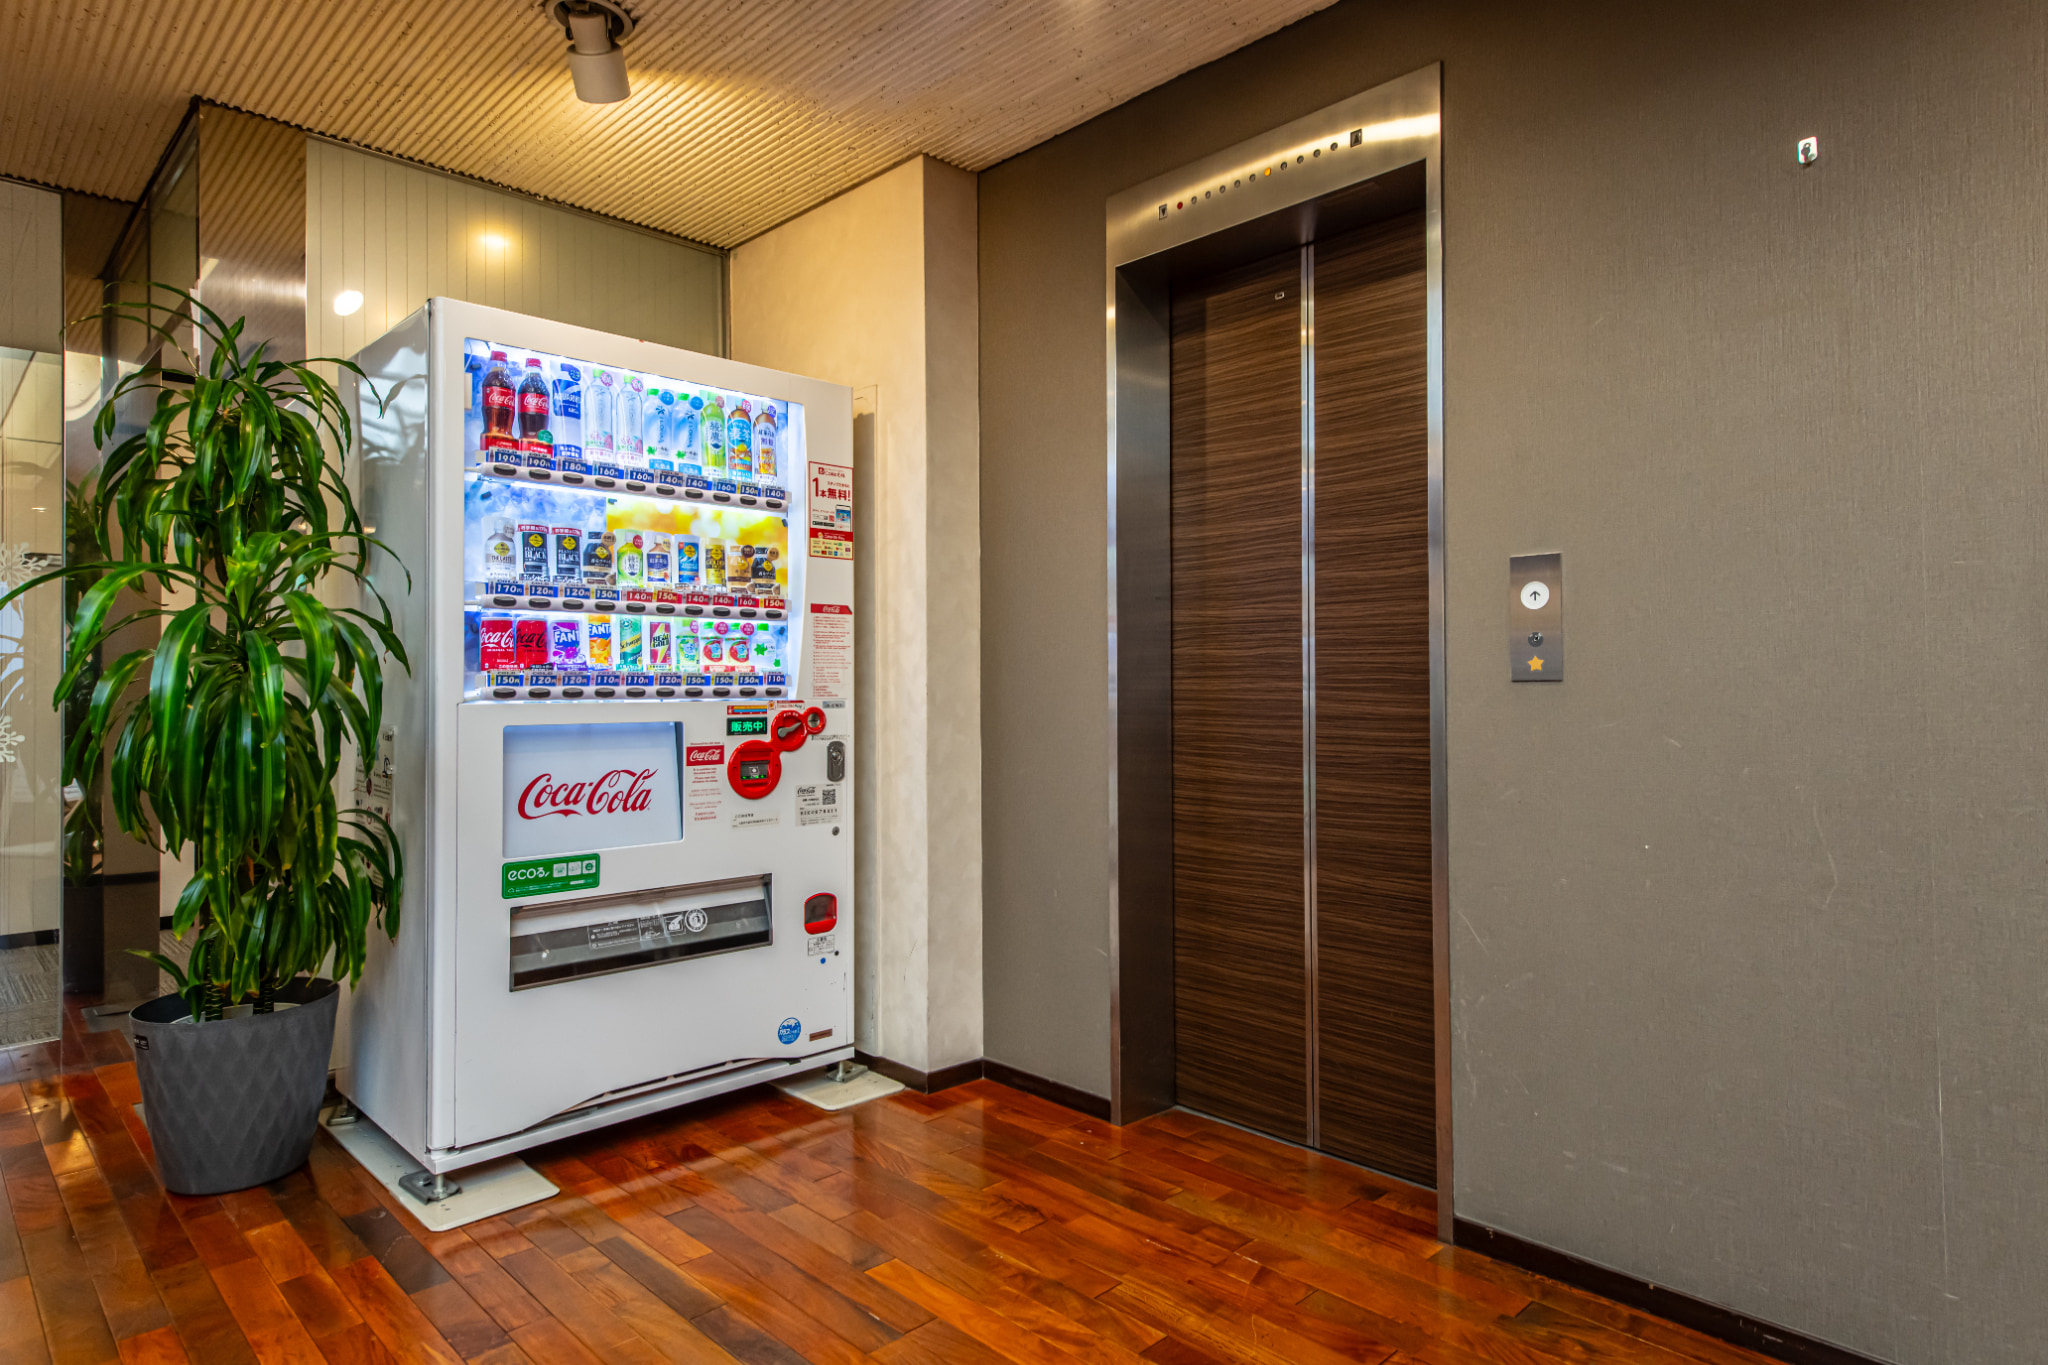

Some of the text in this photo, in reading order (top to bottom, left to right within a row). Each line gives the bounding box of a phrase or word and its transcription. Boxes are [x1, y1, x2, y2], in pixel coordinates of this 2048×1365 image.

[812, 477, 851, 502] 1本無料!
[731, 720, 763, 732] 販売中
[689, 748, 722, 762] Coca-Cola
[517, 768, 659, 820] Coca-Cola
